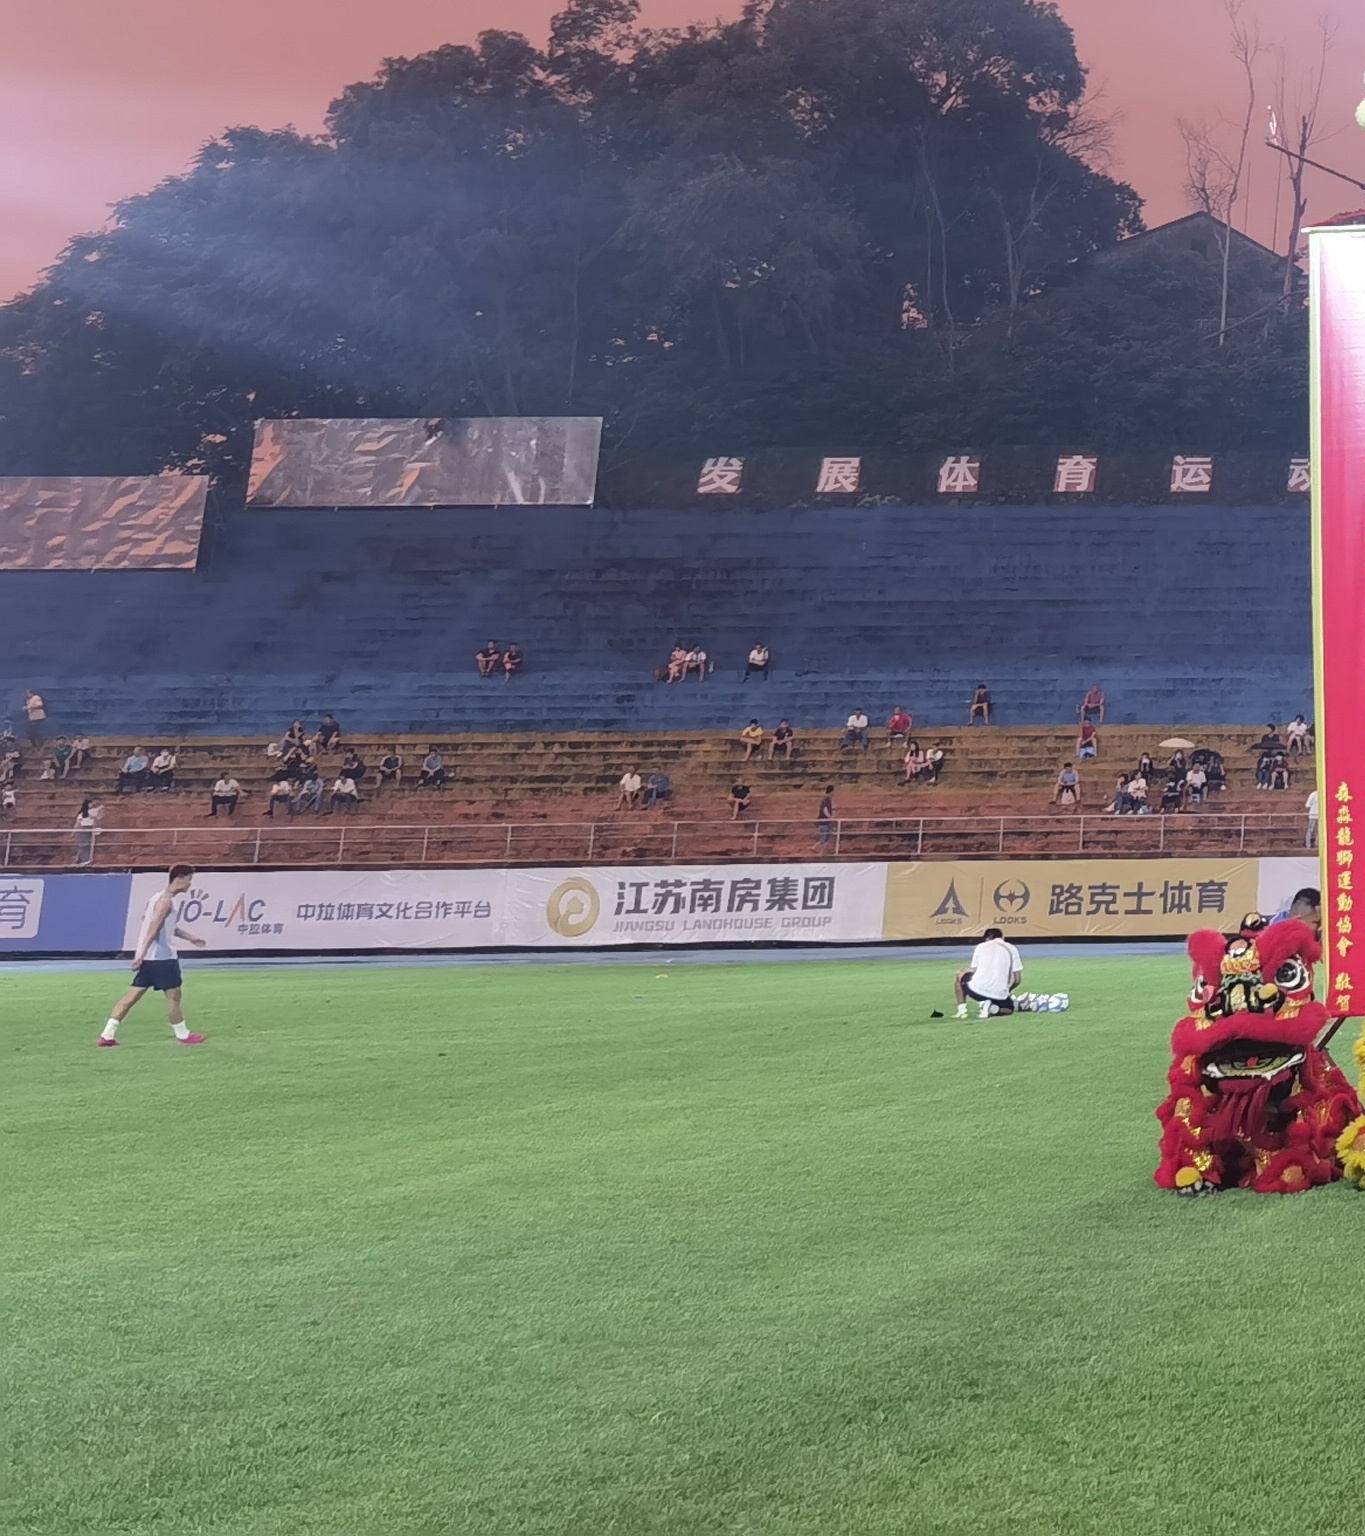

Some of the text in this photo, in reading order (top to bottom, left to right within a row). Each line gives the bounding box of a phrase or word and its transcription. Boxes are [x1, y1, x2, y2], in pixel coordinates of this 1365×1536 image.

[614, 877, 835, 916] 江苏南房集团
[1048, 880, 1229, 916] 路克士体育
[296, 901, 491, 921] 中拉体育文化合作平台
[613, 916, 832, 932] JIANGSU LANDHOUSE GROUP
